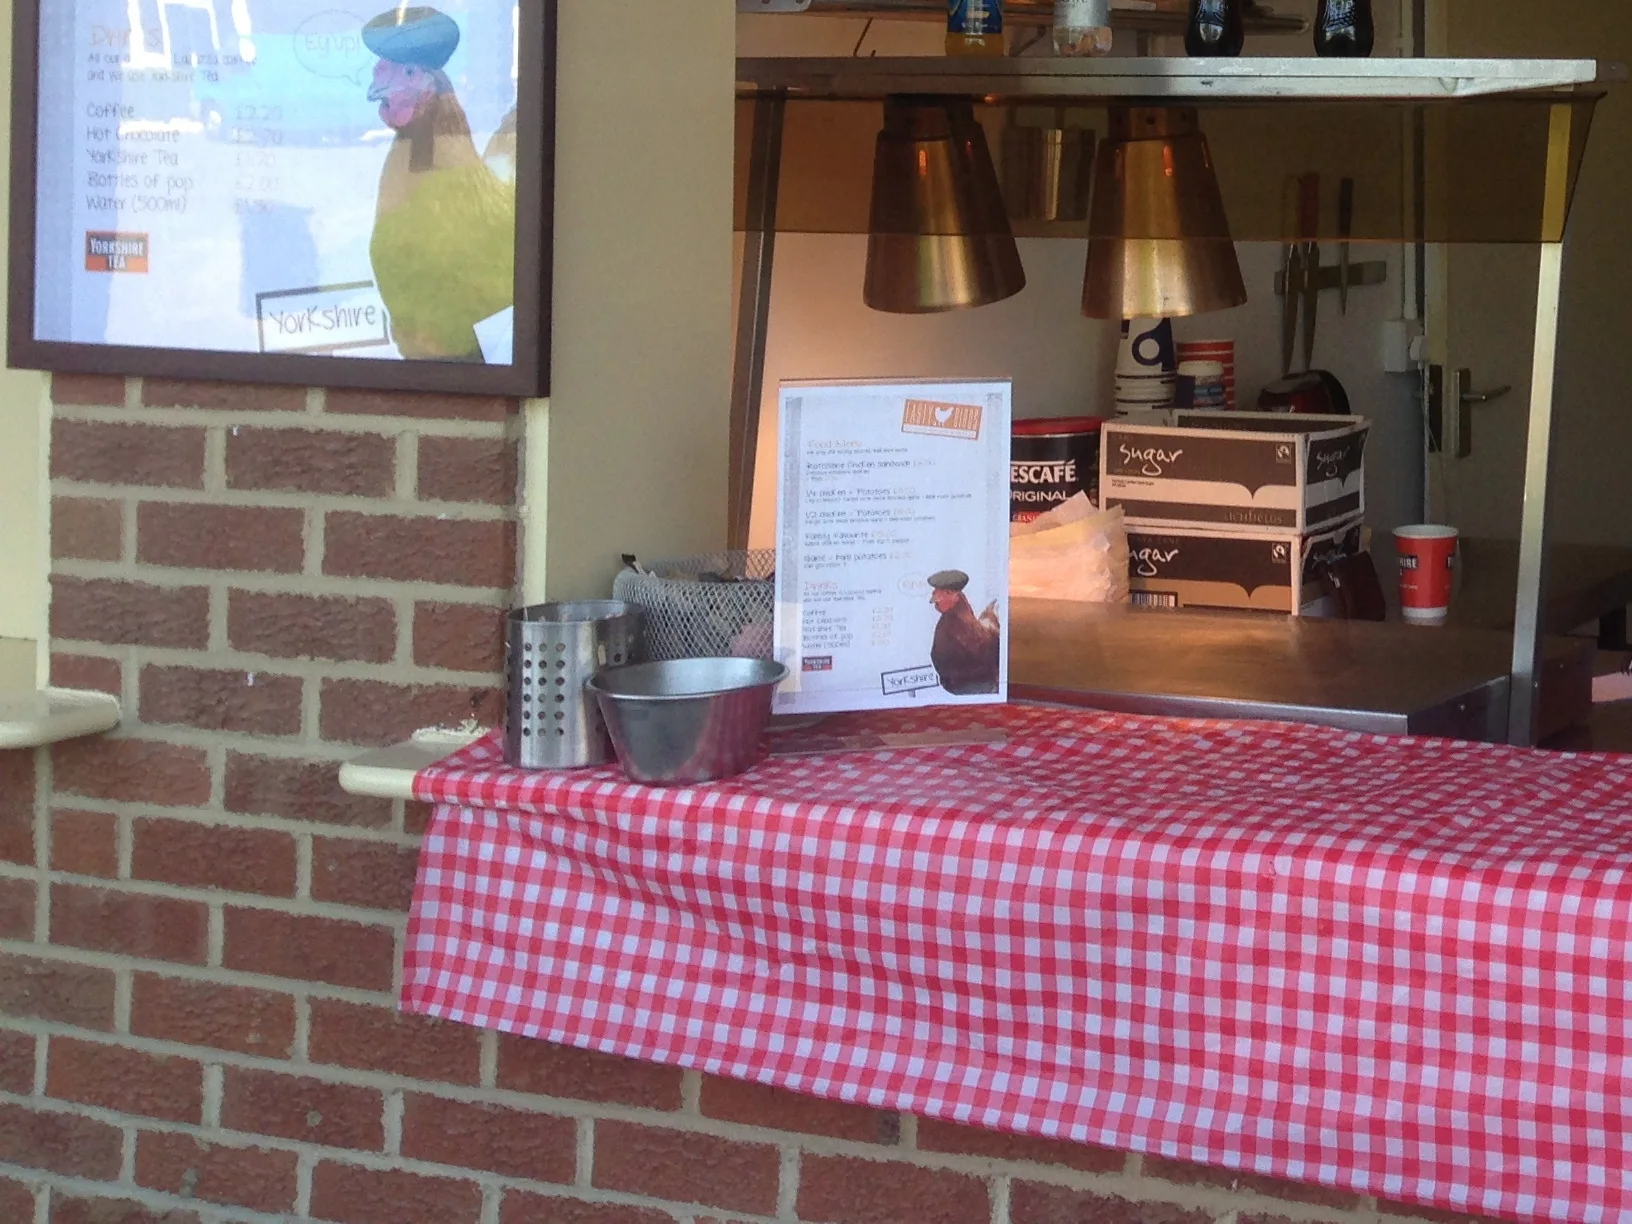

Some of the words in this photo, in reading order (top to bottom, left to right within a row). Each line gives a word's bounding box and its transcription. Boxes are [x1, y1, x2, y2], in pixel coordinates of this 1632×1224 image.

[86, 102, 135, 119] Coffee
[157, 148, 179, 166] Tea
[87, 172, 138, 188] Bottles
[144, 173, 158, 188] of
[167, 176, 194, 194] pop
[86, 195, 127, 210] Water
[132, 194, 188, 215] (500ml)
[90, 237, 144, 254] YORKSHIRE
[108, 255, 127, 270] TEA
[1010, 459, 1076, 484] ESCAFÉ
[1009, 489, 1067, 503] RIGINAL
